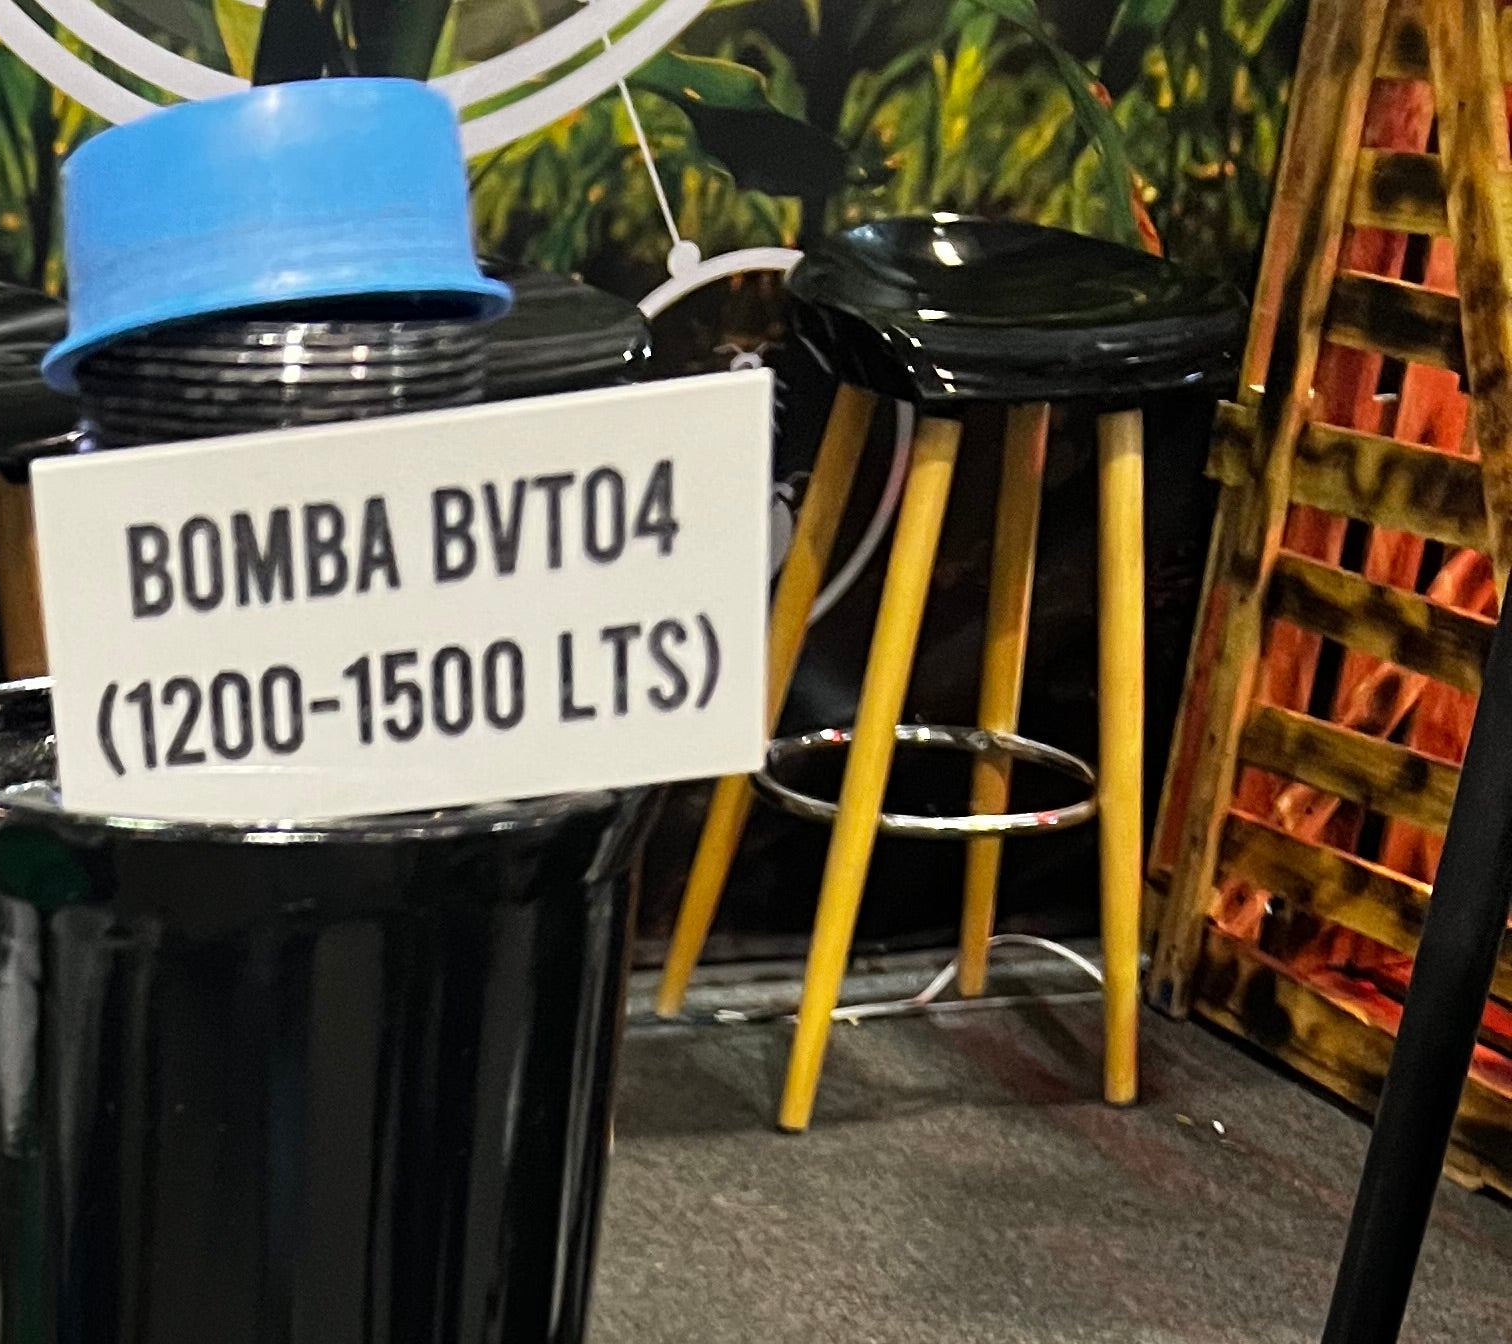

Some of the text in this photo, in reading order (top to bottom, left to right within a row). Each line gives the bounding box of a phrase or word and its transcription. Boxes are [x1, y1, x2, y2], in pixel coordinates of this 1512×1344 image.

[124, 459, 680, 620] BOMBA BVT04
[96, 612, 722, 776] (1200-1500 LTS)
